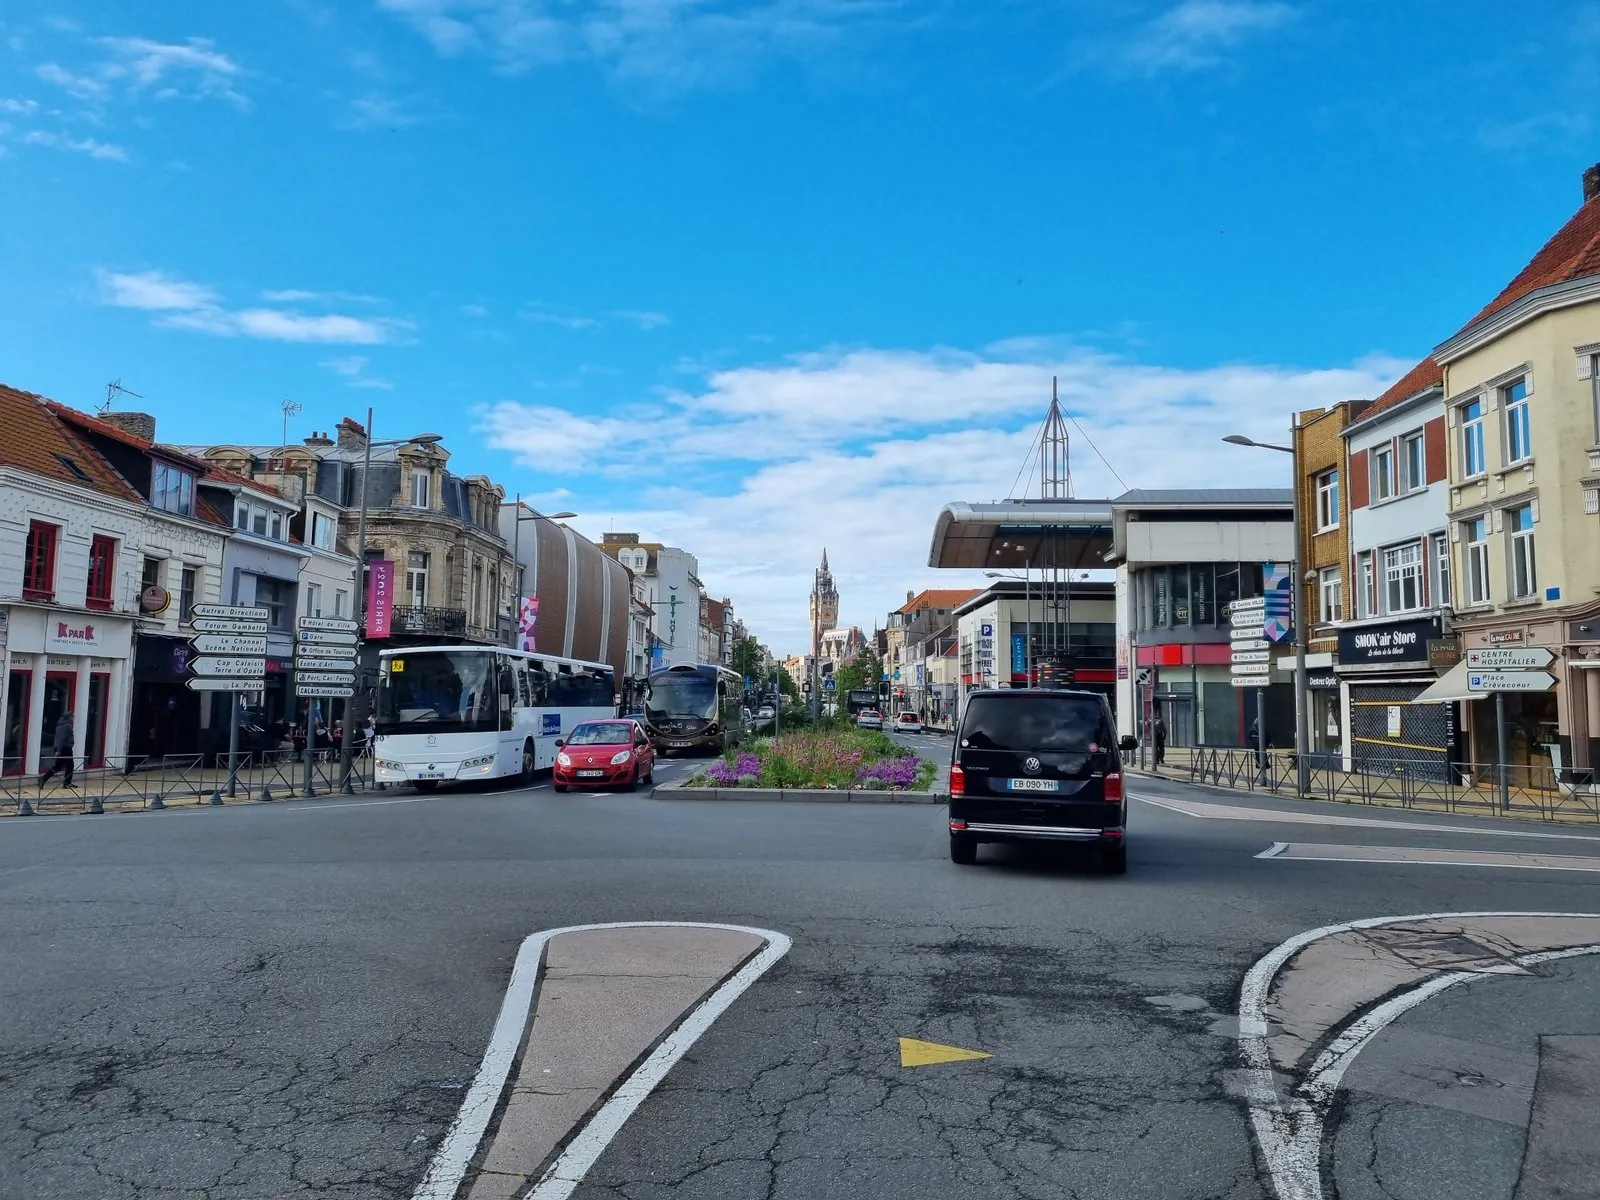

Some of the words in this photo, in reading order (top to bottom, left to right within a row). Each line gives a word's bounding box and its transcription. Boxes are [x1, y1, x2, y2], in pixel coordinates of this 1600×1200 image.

[230, 608, 266, 617] Directions
[1354, 632, 1392, 648] SMOK'air
[1392, 630, 1416, 645] Store
[216, 660, 231, 668] Cap
[981, 660, 992, 668] FREE
[236, 667, 264, 676] d'Opale
[1026, 780, 1042, 788] 090
[1042, 780, 1054, 788] YH
